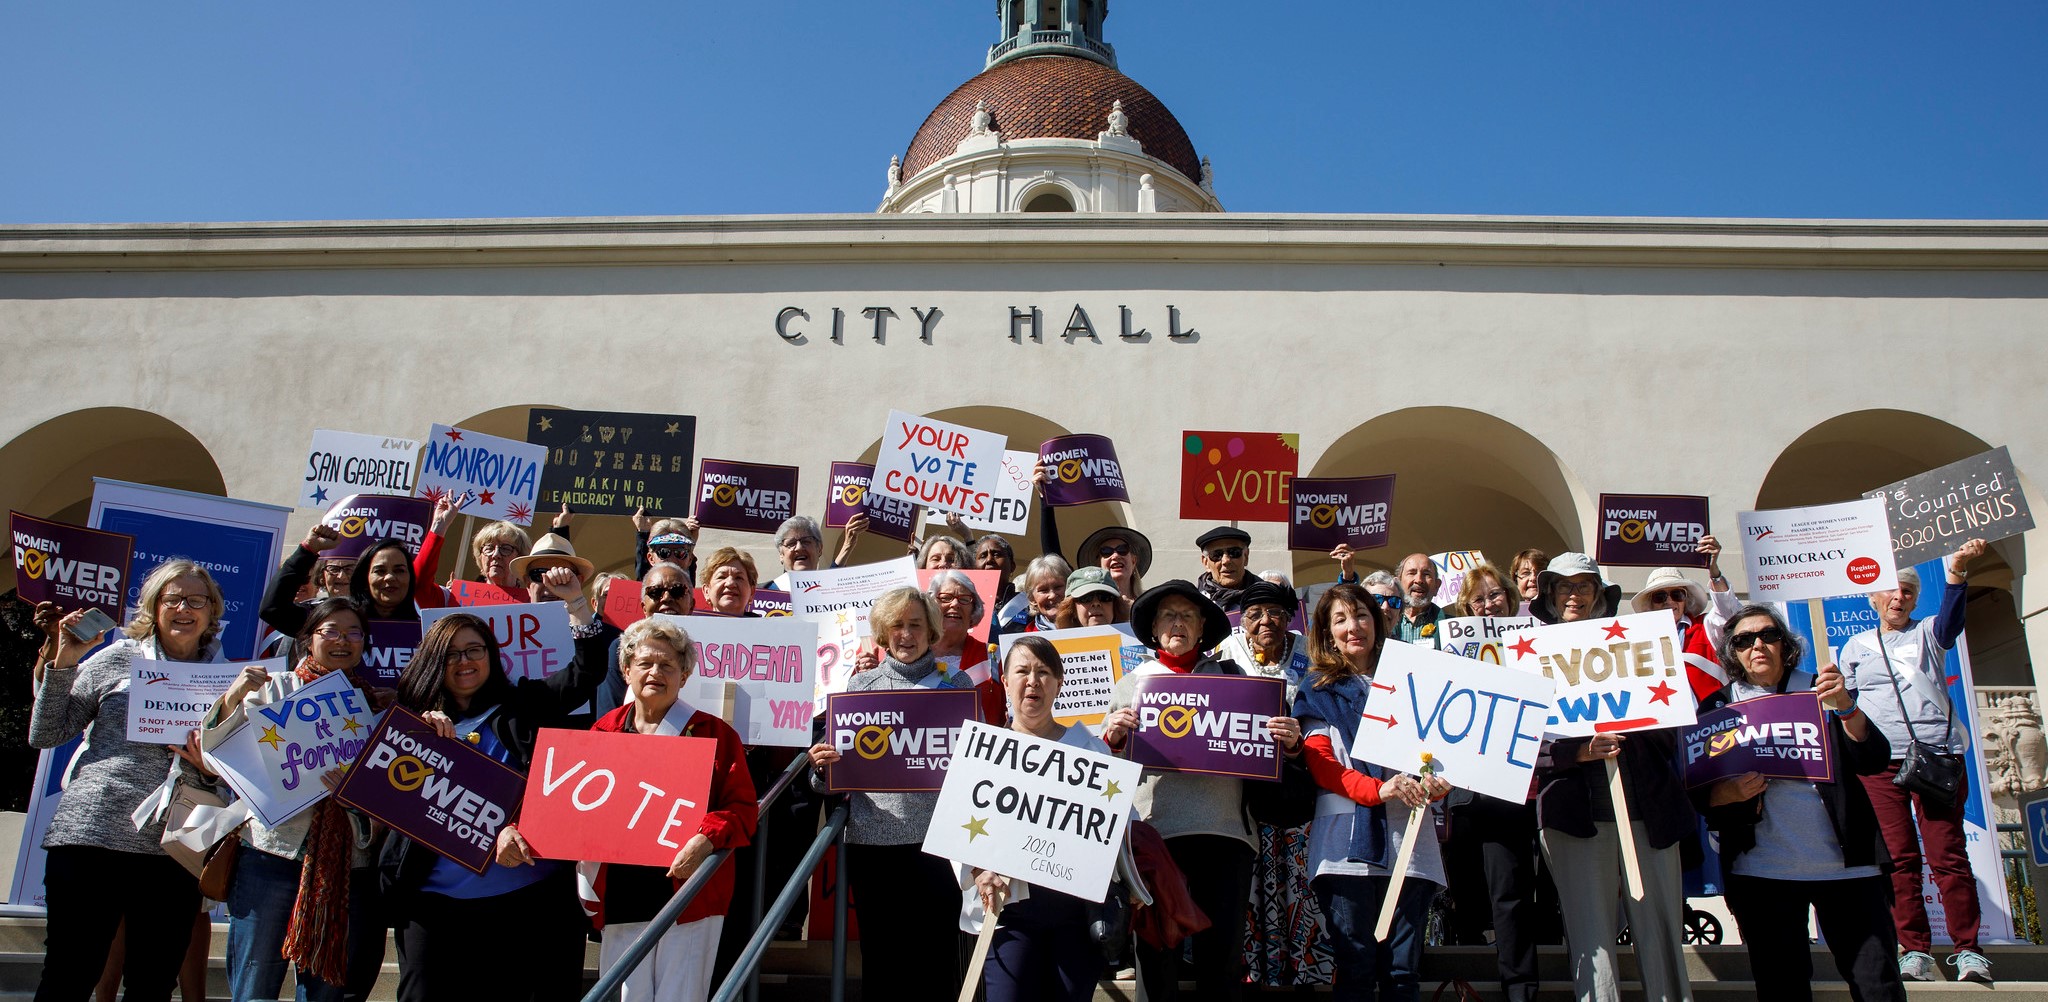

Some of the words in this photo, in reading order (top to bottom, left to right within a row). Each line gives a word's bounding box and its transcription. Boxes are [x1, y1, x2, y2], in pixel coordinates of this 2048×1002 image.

[775, 306, 938, 341] CITY
[1008, 303, 1195, 339] HALL
[382, 438, 412, 450] LWV
[582, 426, 632, 444] LWV
[898, 422, 969, 459] YOUR
[594, 450, 682, 472] YEARS
[1043, 448, 1088, 464] WOMEN
[306, 452, 342, 483] SAN
[344, 457, 412, 491] GABRIEL
[425, 440, 538, 500] MONROVIA
[704, 473, 747, 486] WOMEN
[911, 452, 977, 486] VOTE
[1002, 456, 1030, 490] 2020
[1045, 458, 1122, 484] POWER
[574, 476, 644, 492] MAKING
[886, 470, 990, 514] COUNTS
[1107, 478, 1124, 488] VOTE
[1216, 470, 1293, 504] VOTE
[543, 490, 615, 506] DEMOCRACY
[624, 494, 663, 510] WORK
[702, 484, 790, 510] POWER
[832, 486, 912, 518] POWER
[1296, 494, 1348, 504] WOMEN
[332, 508, 378, 518] WOMEN
[760, 509, 790, 520] VOTE
[883, 512, 909, 528] VOTE
[1296, 502, 1387, 529] POWER
[1606, 509, 1656, 520] WOMEN
[1891, 526, 1935, 551] 2020
[1936, 494, 2016, 537] CENSUS
[1361, 524, 1386, 535] VOTE
[1604, 520, 1704, 544] POWER
[1748, 525, 1772, 536] LWV
[14, 531, 60, 554] WOMEN
[1430, 551, 1480, 573] VOTE
[1758, 549, 1847, 566] DEMOCRACY
[1850, 564, 1877, 572] Register
[14, 546, 121, 592] POWER
[1787, 570, 1825, 580] SPECTATOR
[56, 584, 74, 594] THE
[77, 588, 118, 606] VOTE
[796, 580, 820, 589] LWV
[754, 600, 792, 610] WOME
[806, 598, 876, 614] DEMOCRAC
[1832, 610, 1880, 622] LEAGU
[489, 613, 543, 650] UR
[1448, 620, 1476, 638] Be
[1826, 624, 1870, 637] OMEN
[841, 624, 854, 676] VOTE
[693, 642, 802, 683] ASADENA
[817, 643, 840, 686] ?
[1293, 660, 1306, 669] LWV
[138, 670, 170, 680] LWV
[144, 700, 212, 713] DEMOCR
[259, 690, 363, 729] VOTE
[1142, 692, 1210, 706] WOMEN
[1546, 690, 1631, 725] WV
[770, 700, 812, 732] YAY!
[835, 712, 904, 726] WOMEN
[1140, 704, 1272, 742] POWER
[1408, 672, 1549, 770] VOTE
[316, 718, 334, 740] it
[1686, 714, 1748, 744] WOMEN
[385, 726, 454, 774] WOMEN
[1208, 739, 1227, 748] THE
[1230, 740, 1274, 758] VOTE
[1687, 722, 1821, 765] POWER
[1774, 747, 1822, 760] VOTE
[906, 758, 925, 766] THE
[926, 758, 950, 770] VO
[964, 726, 1108, 790] ¡HAGASE
[365, 743, 505, 836] POWER
[543, 746, 696, 848] VOTE
[972, 780, 1118, 846] CONTAR!
[428, 806, 448, 824] THE
[448, 816, 494, 852] VOTE
[1022, 836, 1056, 858] 2020
[1031, 858, 1074, 880] CENSUS
